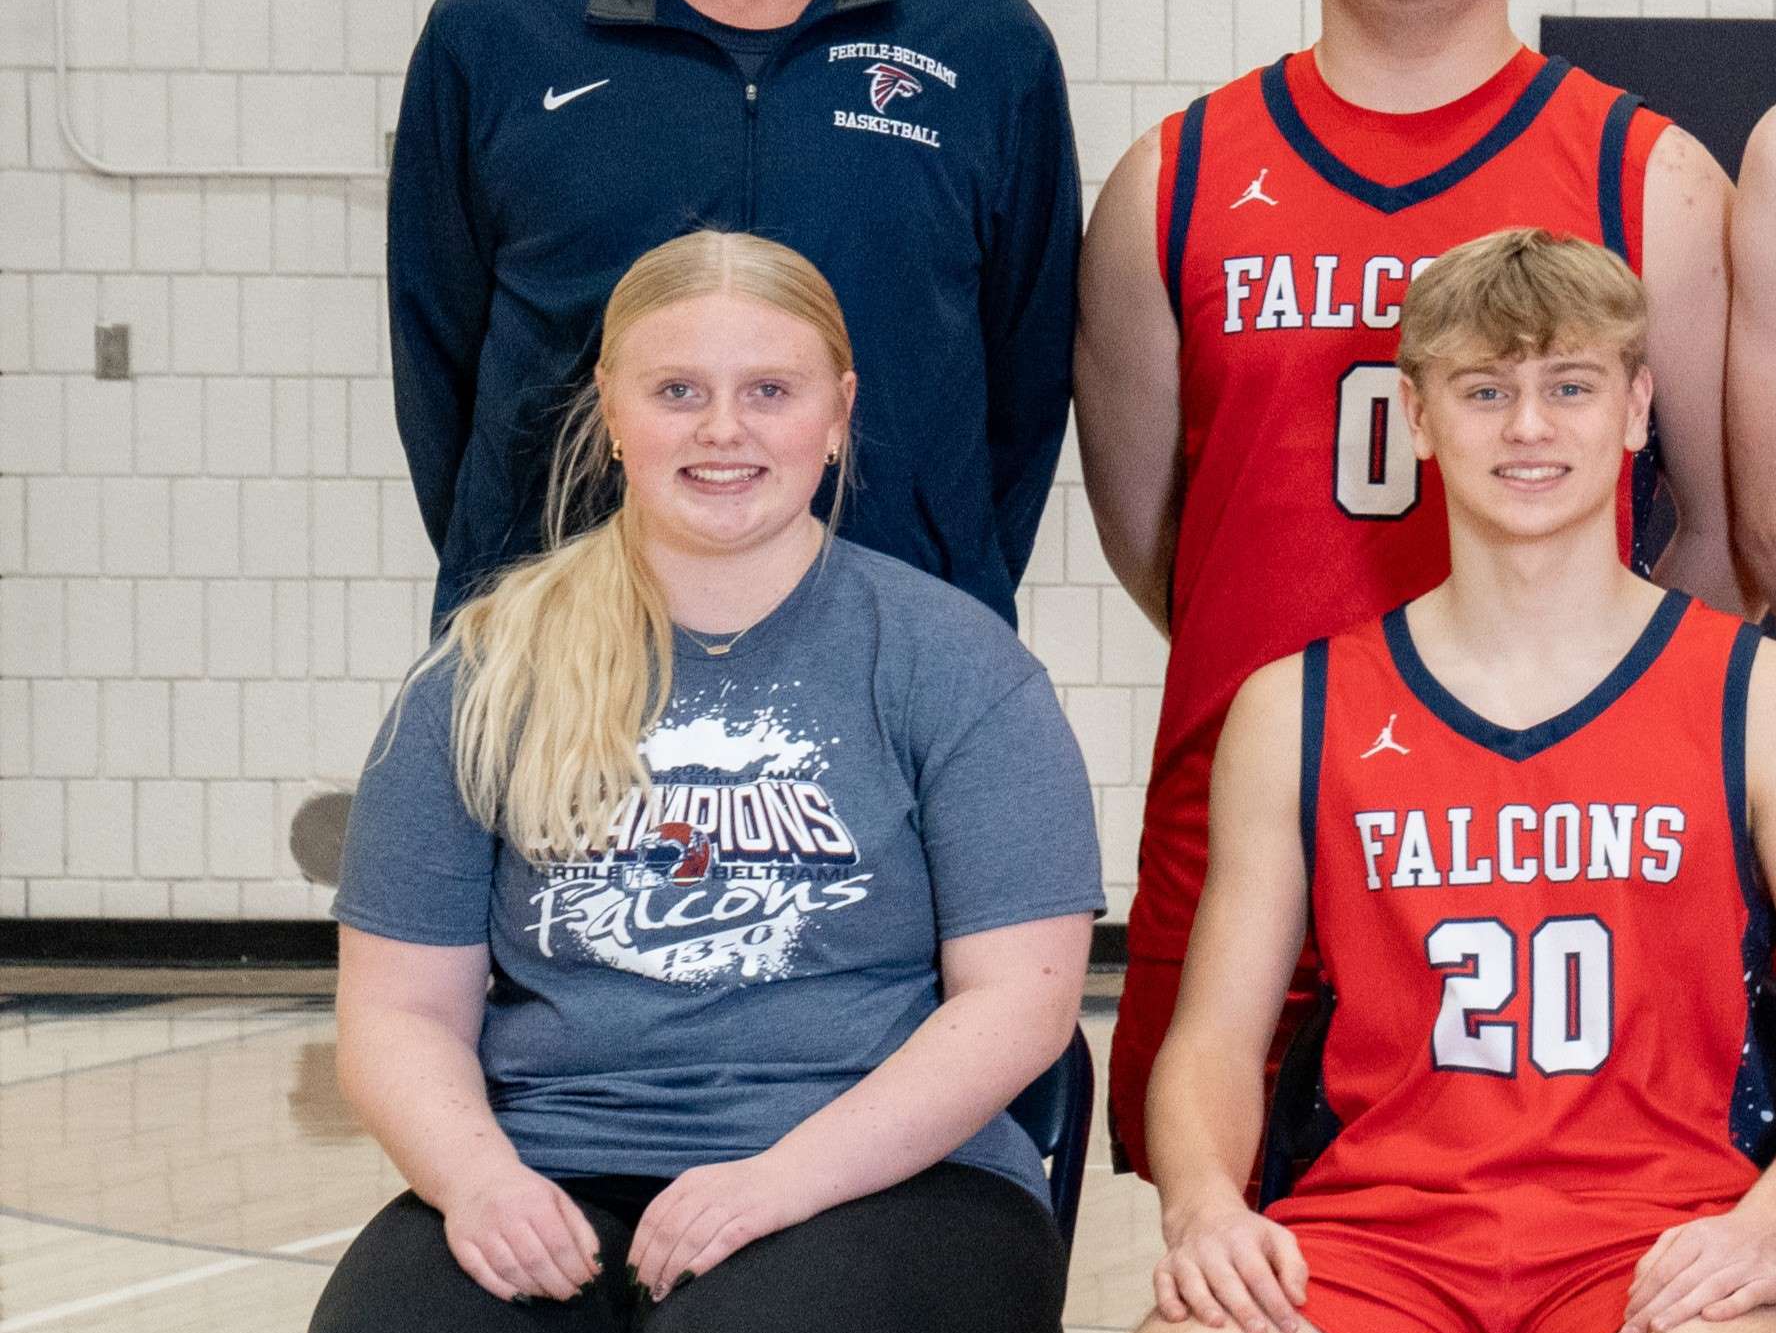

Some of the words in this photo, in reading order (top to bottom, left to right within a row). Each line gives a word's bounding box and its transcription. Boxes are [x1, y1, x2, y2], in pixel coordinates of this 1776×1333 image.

[828, 42, 957, 89] FERTILE-BELTRAMI
[832, 110, 941, 148] BASKETBALL
[1223, 254, 1438, 334] FALC
[1333, 361, 1421, 521] 0
[535, 778, 855, 864] AMPIONS
[1354, 801, 1687, 891] FALCONS
[523, 873, 875, 958] Falcons
[1424, 914, 1614, 1079] 20
